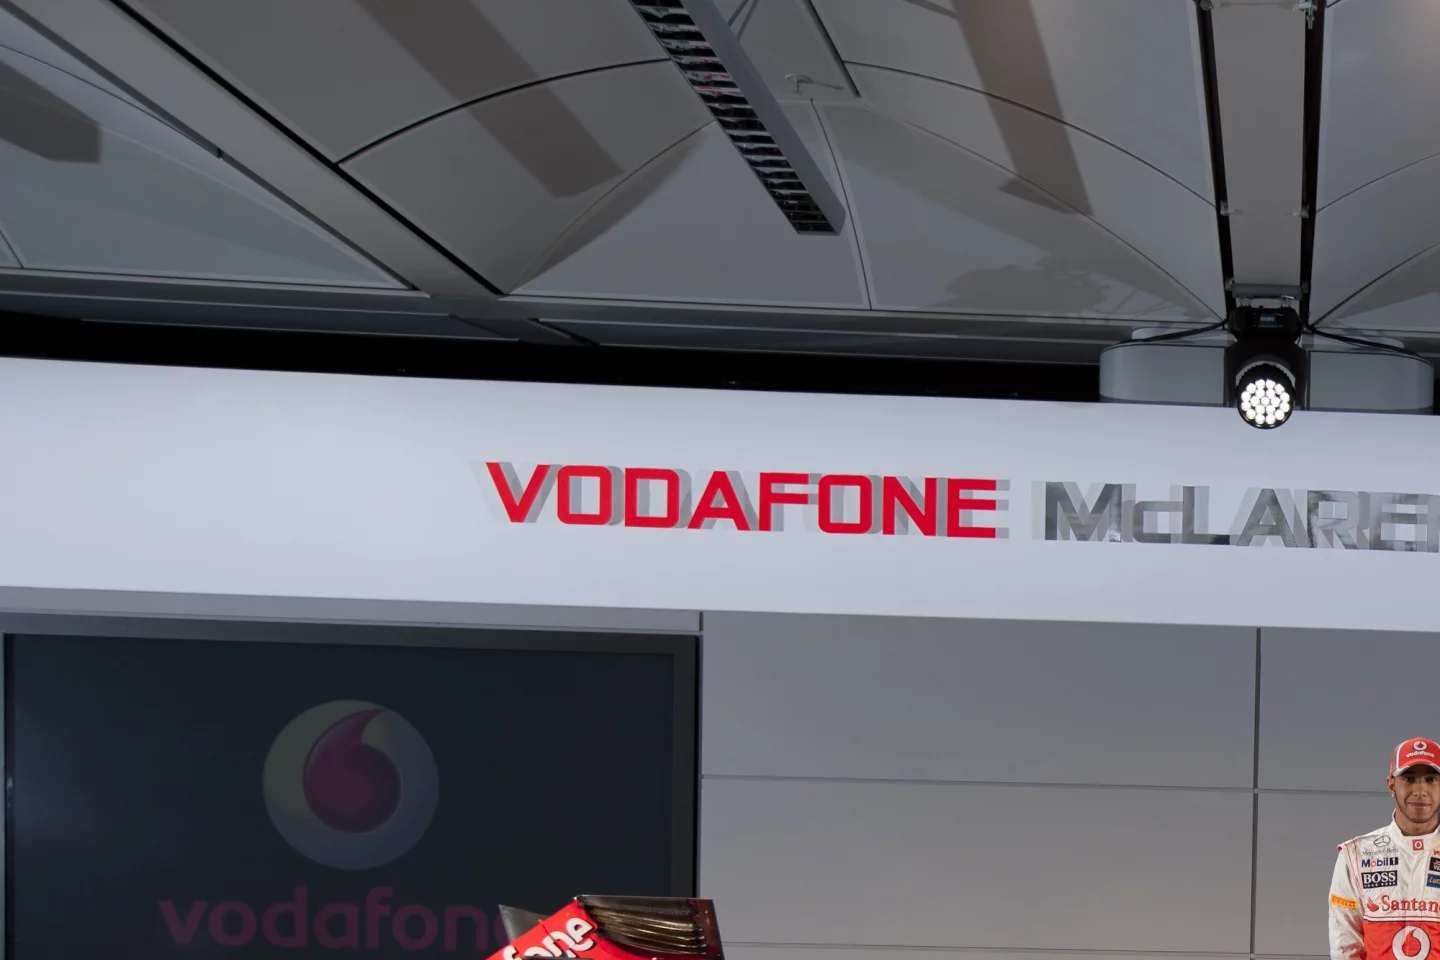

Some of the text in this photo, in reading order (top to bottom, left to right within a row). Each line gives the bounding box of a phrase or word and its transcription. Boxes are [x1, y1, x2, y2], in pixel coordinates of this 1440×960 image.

[486, 462, 997, 539] VODAFONE
[1405, 751, 1435, 759] vodafone
[1362, 857, 1389, 868] Mobil
[1363, 871, 1397, 885] BOSS
